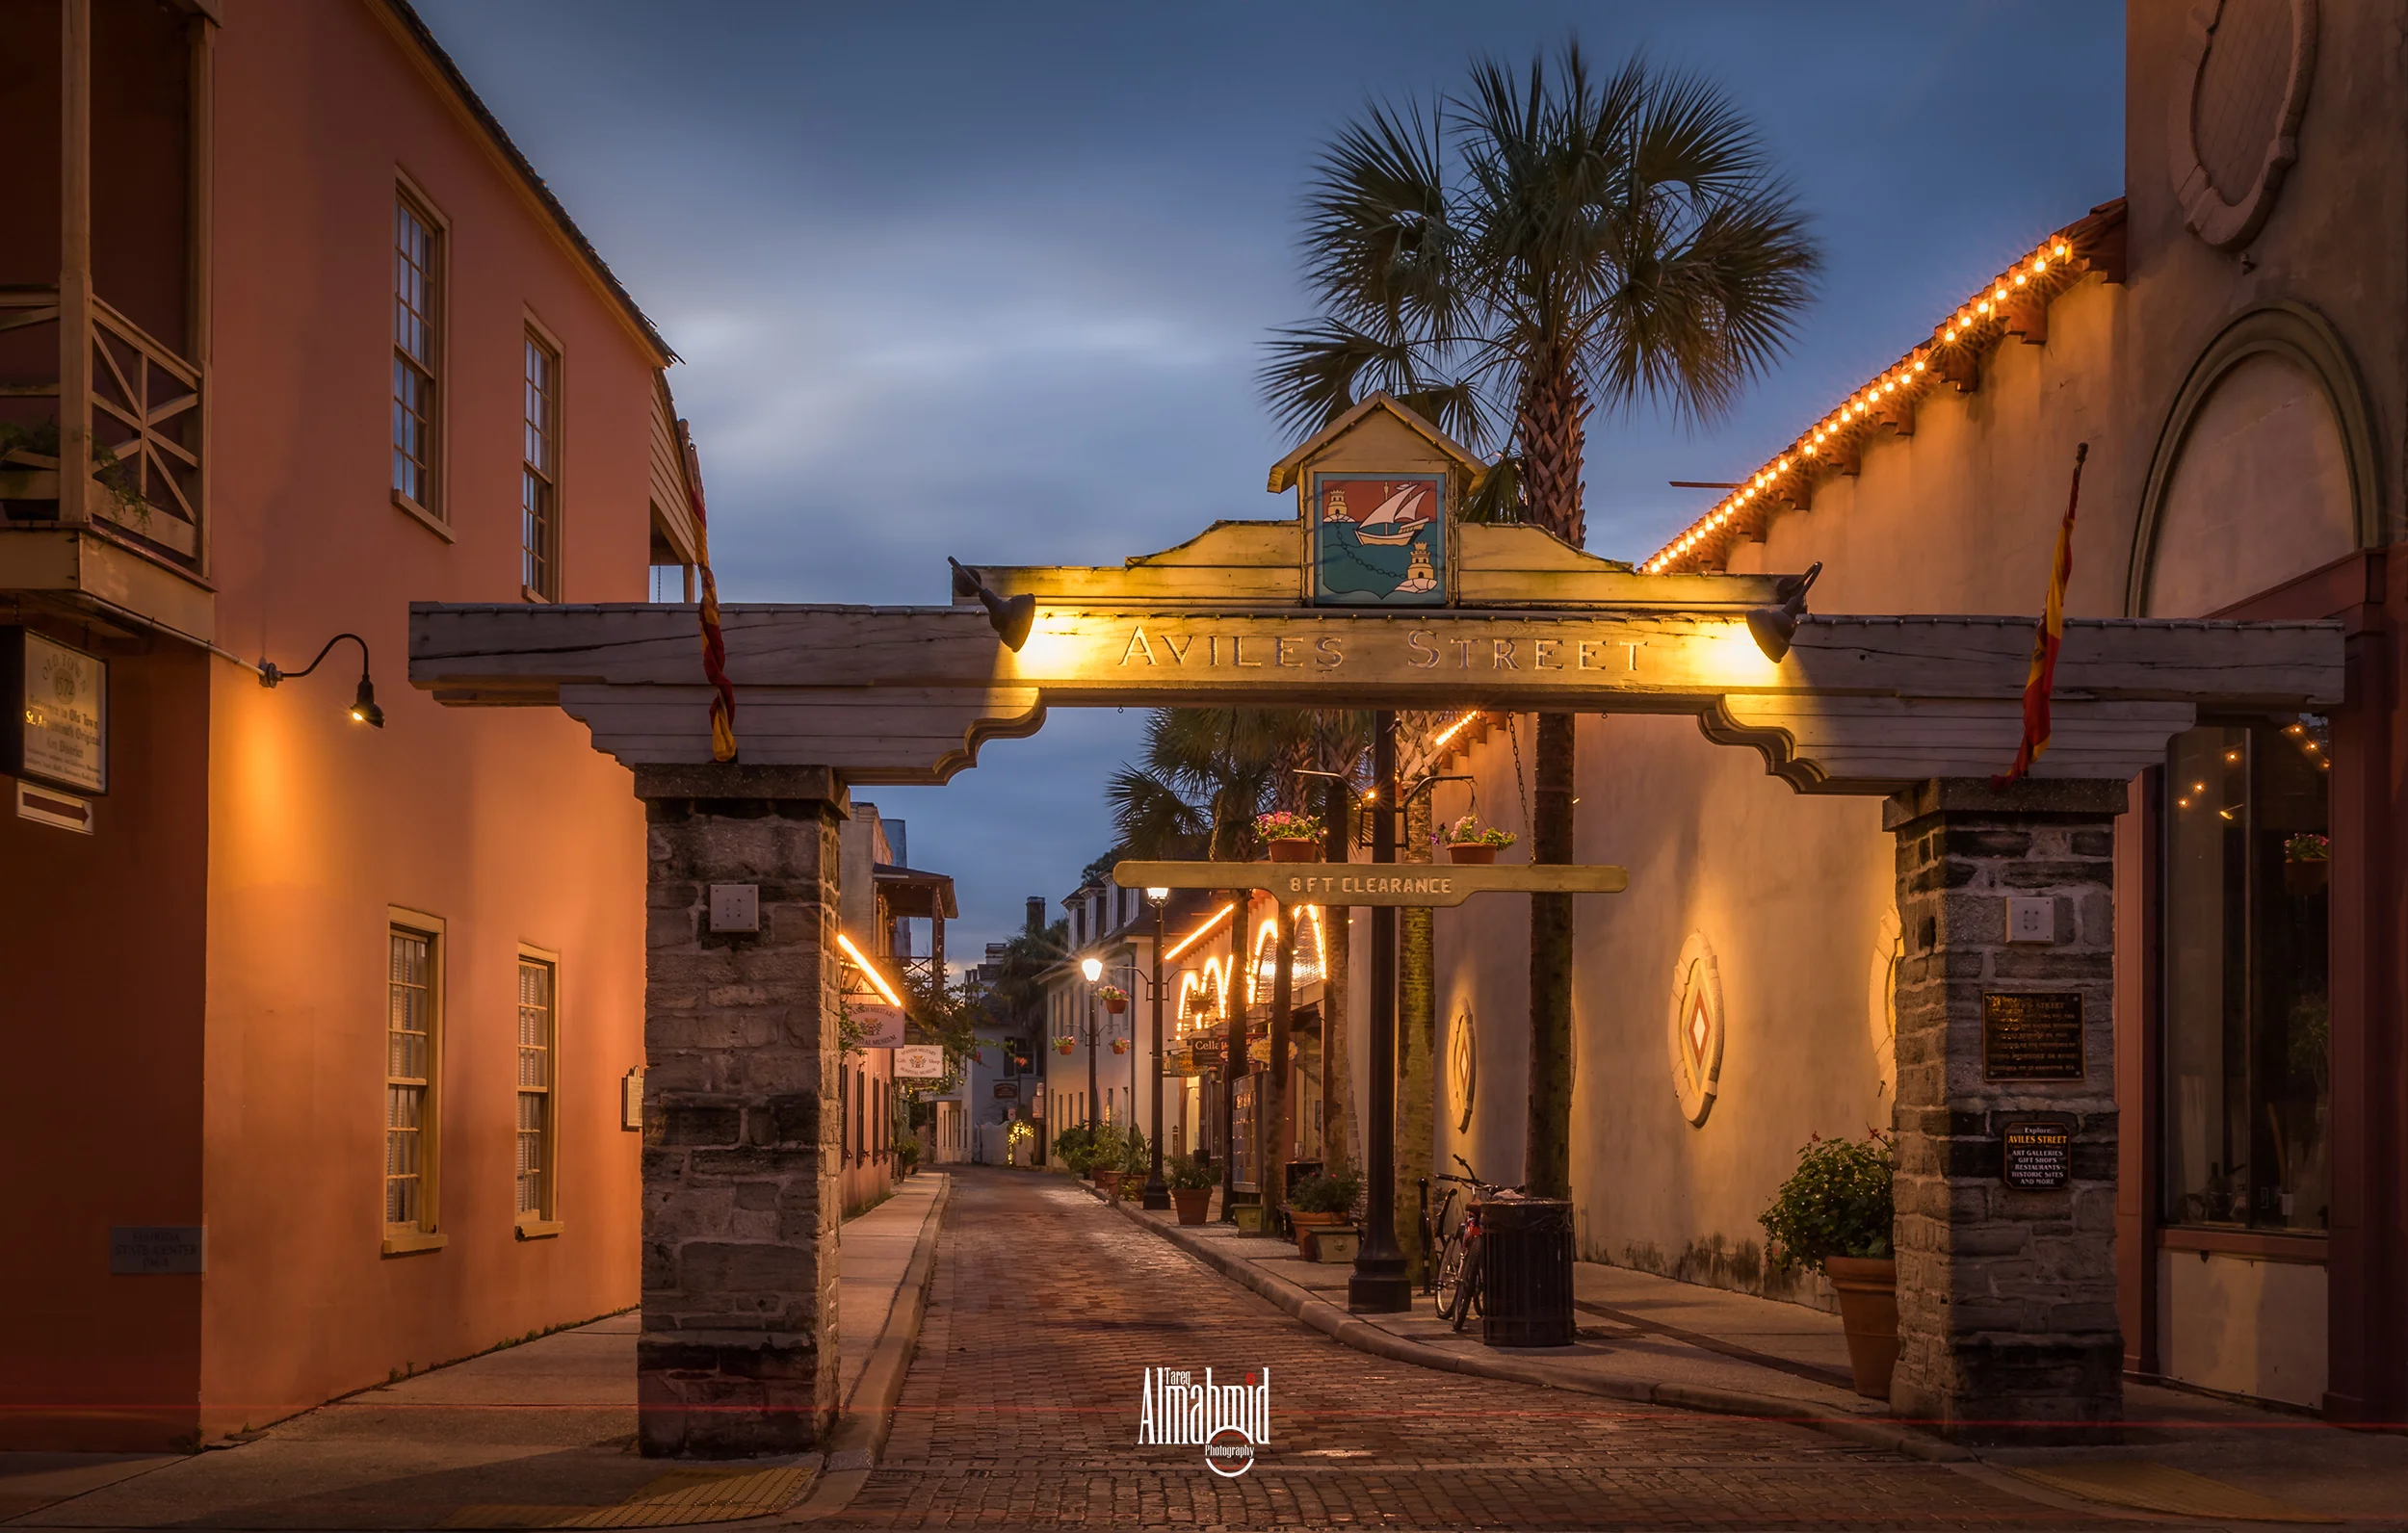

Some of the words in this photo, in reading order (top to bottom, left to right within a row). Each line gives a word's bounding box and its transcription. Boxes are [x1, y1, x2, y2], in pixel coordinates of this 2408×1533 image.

[1118, 625, 1345, 668] AVILES
[1406, 629, 1648, 672] STREET
[1341, 877, 1453, 895] CLEARANCE
[870, 1006, 898, 1019] MILITARY
[873, 1034, 898, 1046] MUSEUM
[2008, 1135, 2036, 1144] AVILES
[2037, 1135, 2067, 1144] STREET
[115, 1244, 148, 1256] STATE
[154, 1244, 197, 1256] CENTER
